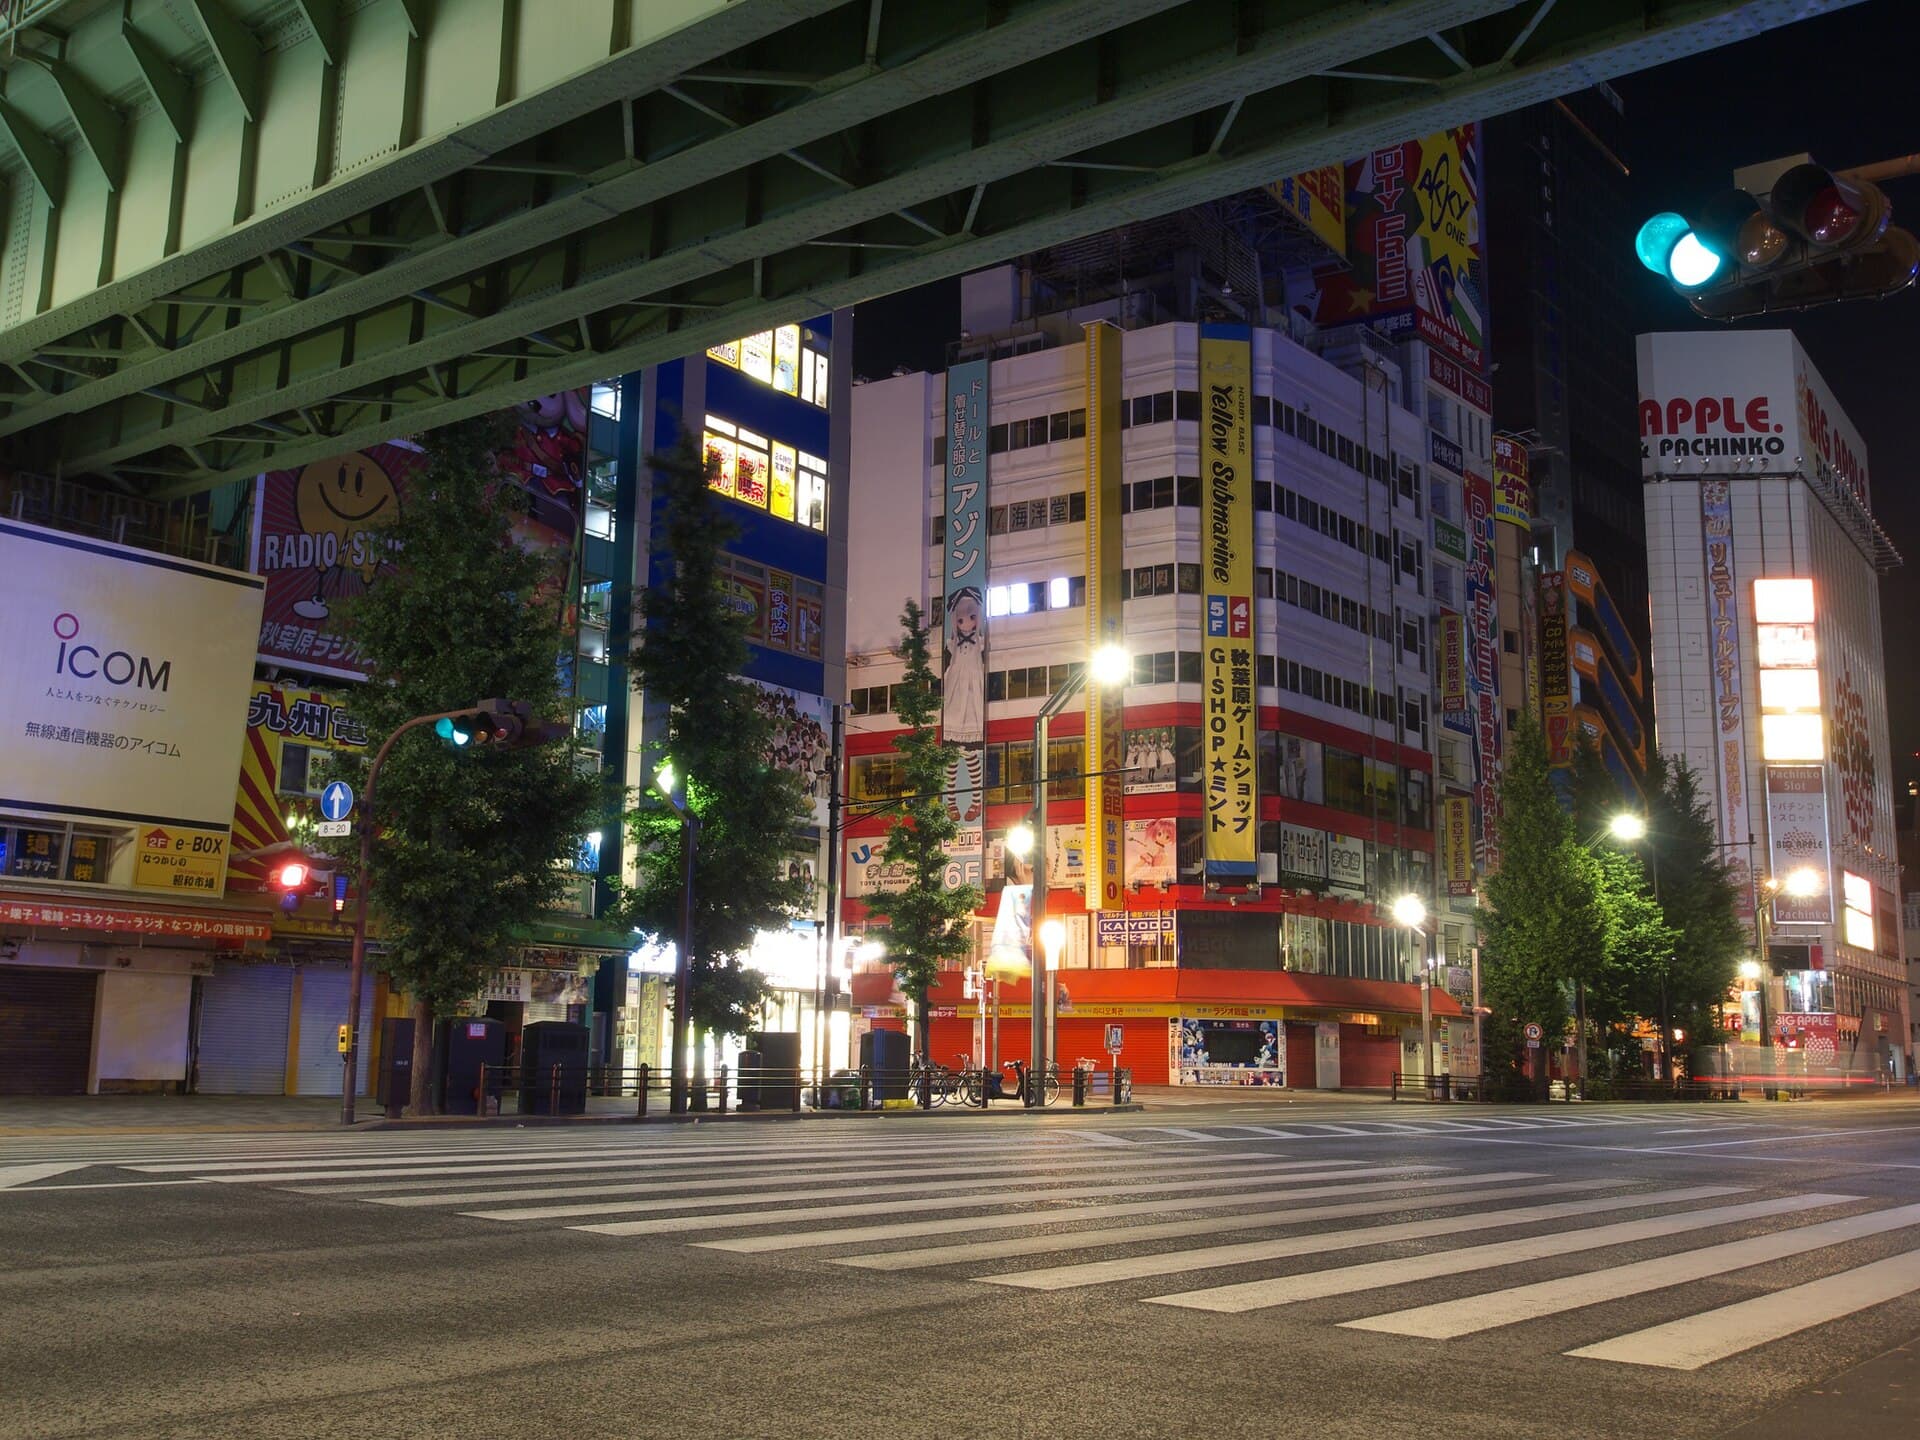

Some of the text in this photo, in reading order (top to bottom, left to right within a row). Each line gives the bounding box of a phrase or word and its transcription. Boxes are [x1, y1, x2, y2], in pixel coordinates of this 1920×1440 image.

[1445, 222, 1465, 247] ONE
[1375, 213, 1408, 302] FREE
[1421, 315, 1443, 340] AKKY
[952, 393, 967, 478] 着せ替え服の
[969, 379, 983, 465] ドールと
[1806, 388, 1830, 462] BIG
[1659, 436, 1785, 457] PACHINKO
[738, 455, 767, 478] ネット
[737, 475, 766, 505] 喫茶
[1211, 384, 1236, 584] Yellow Submarine
[1011, 496, 1068, 529] 海洋堂
[952, 481, 981, 579] アゾン
[264, 532, 338, 570] RADIO
[1470, 492, 1494, 688] DUTY FREE
[1209, 601, 1224, 632] 5F
[1232, 602, 1248, 633] 4F
[1709, 542, 1740, 734] リニューアルオープン
[25, 721, 182, 759] 無線通信機器のアイコム
[1230, 648, 1252, 834] 秋葉原ゲームショップ
[1770, 769, 1820, 779] Pachinko
[1783, 781, 1806, 791] Slot
[148, 837, 168, 849] 2F
[175, 836, 223, 855] e-BOX
[1106, 818, 1118, 877] 秋葉原
[142, 854, 187, 868] なつかしの
[944, 860, 981, 890] 6F
[1778, 911, 1829, 921] Pachinko
[1162, 932, 1175, 945] 7F
[1775, 1015, 1795, 1026] BIG
